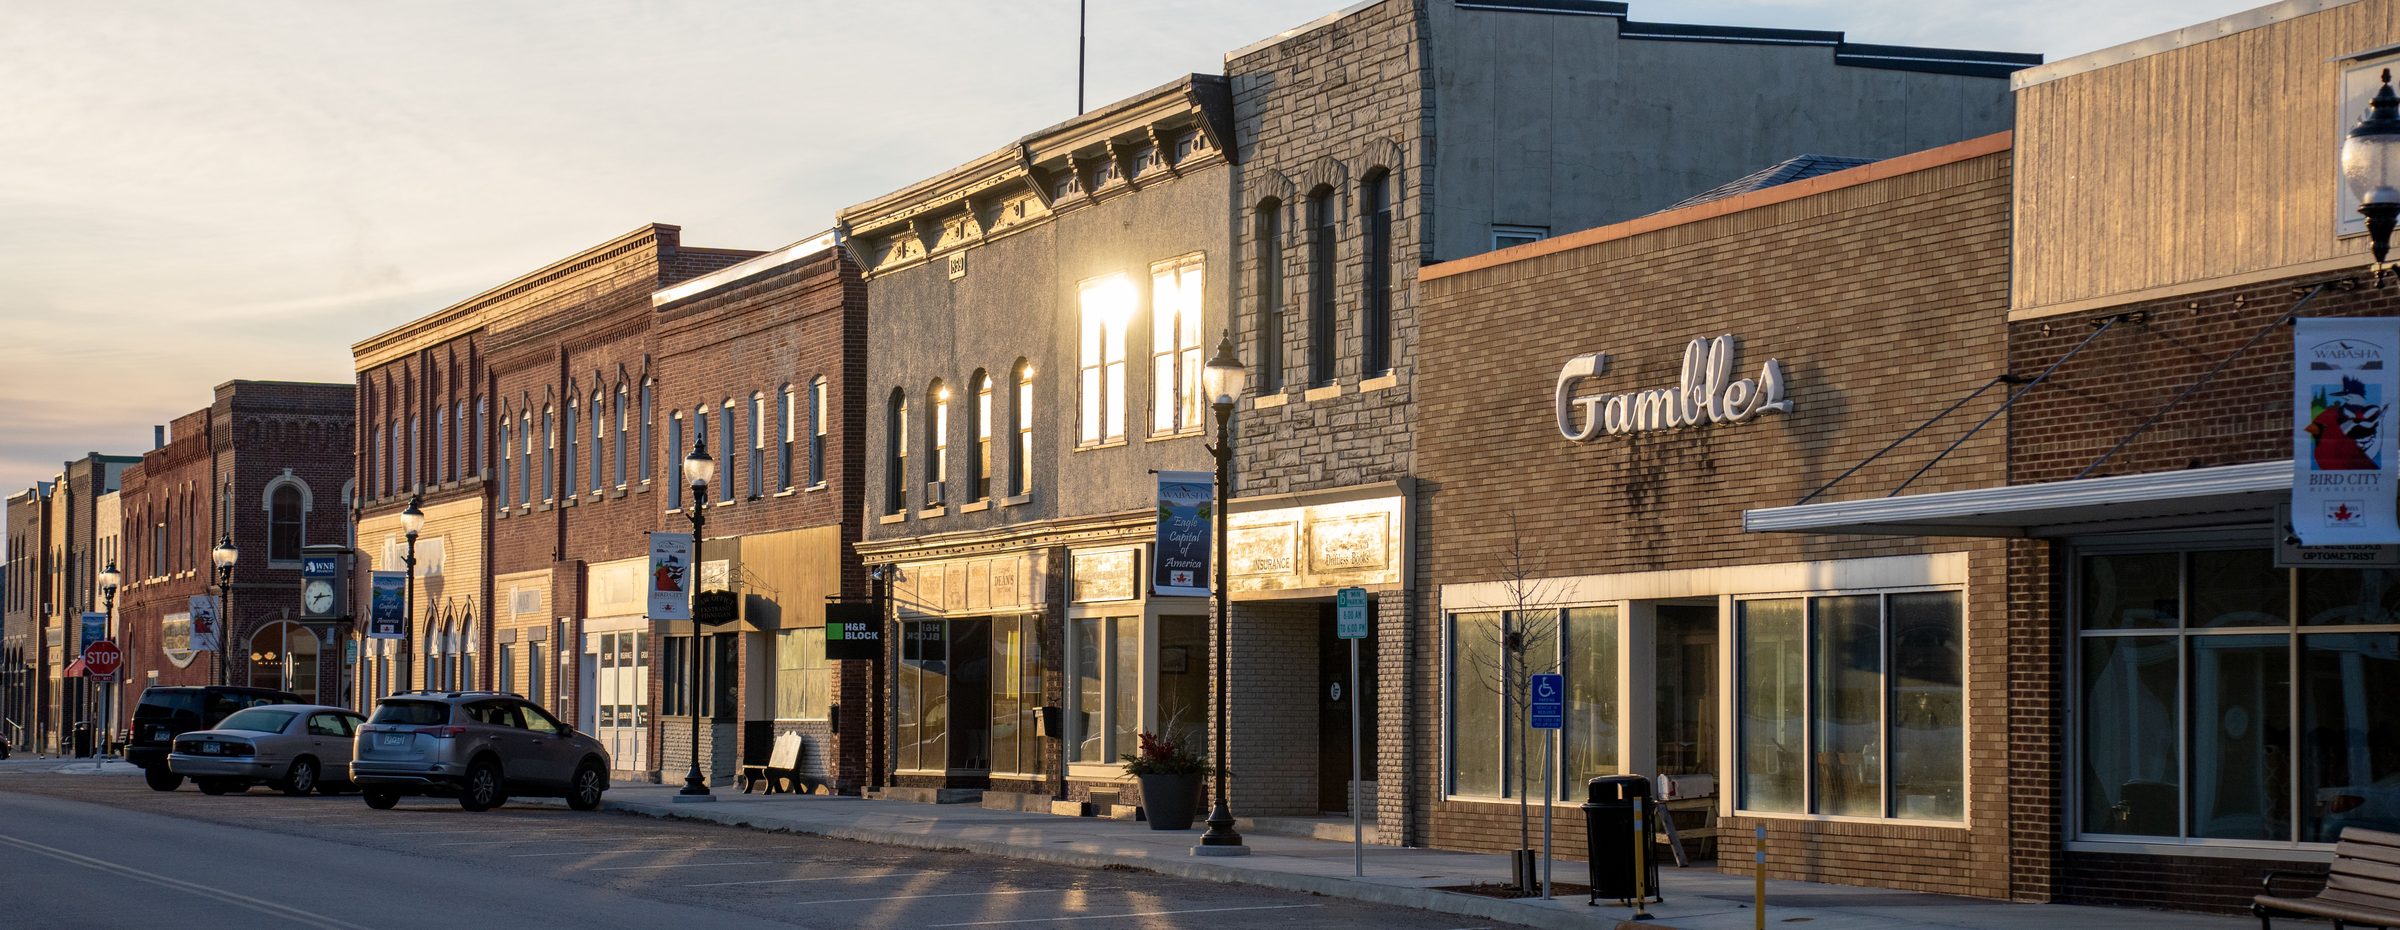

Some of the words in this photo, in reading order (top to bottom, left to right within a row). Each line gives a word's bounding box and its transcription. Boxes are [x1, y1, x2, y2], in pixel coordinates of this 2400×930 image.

[2314, 349, 2380, 359] WABASHA
[1556, 334, 1793, 442] Gambles
[2309, 473, 2345, 486] BIRD
[2347, 473, 2383, 486] CITY
[1162, 490, 1211, 500] WABASHA
[1173, 514, 1199, 532] Eagle
[1169, 530, 1202, 547] Capital
[1180, 543, 1191, 557] of
[2302, 551, 2377, 561] OPTOMETRIST
[1164, 557, 1202, 568] America
[1352, 551, 1370, 565] Books
[316, 562, 335, 570] WNB
[845, 623, 866, 631] H&R
[845, 631, 879, 640] BLOCK
[87, 651, 119, 665] STOP
